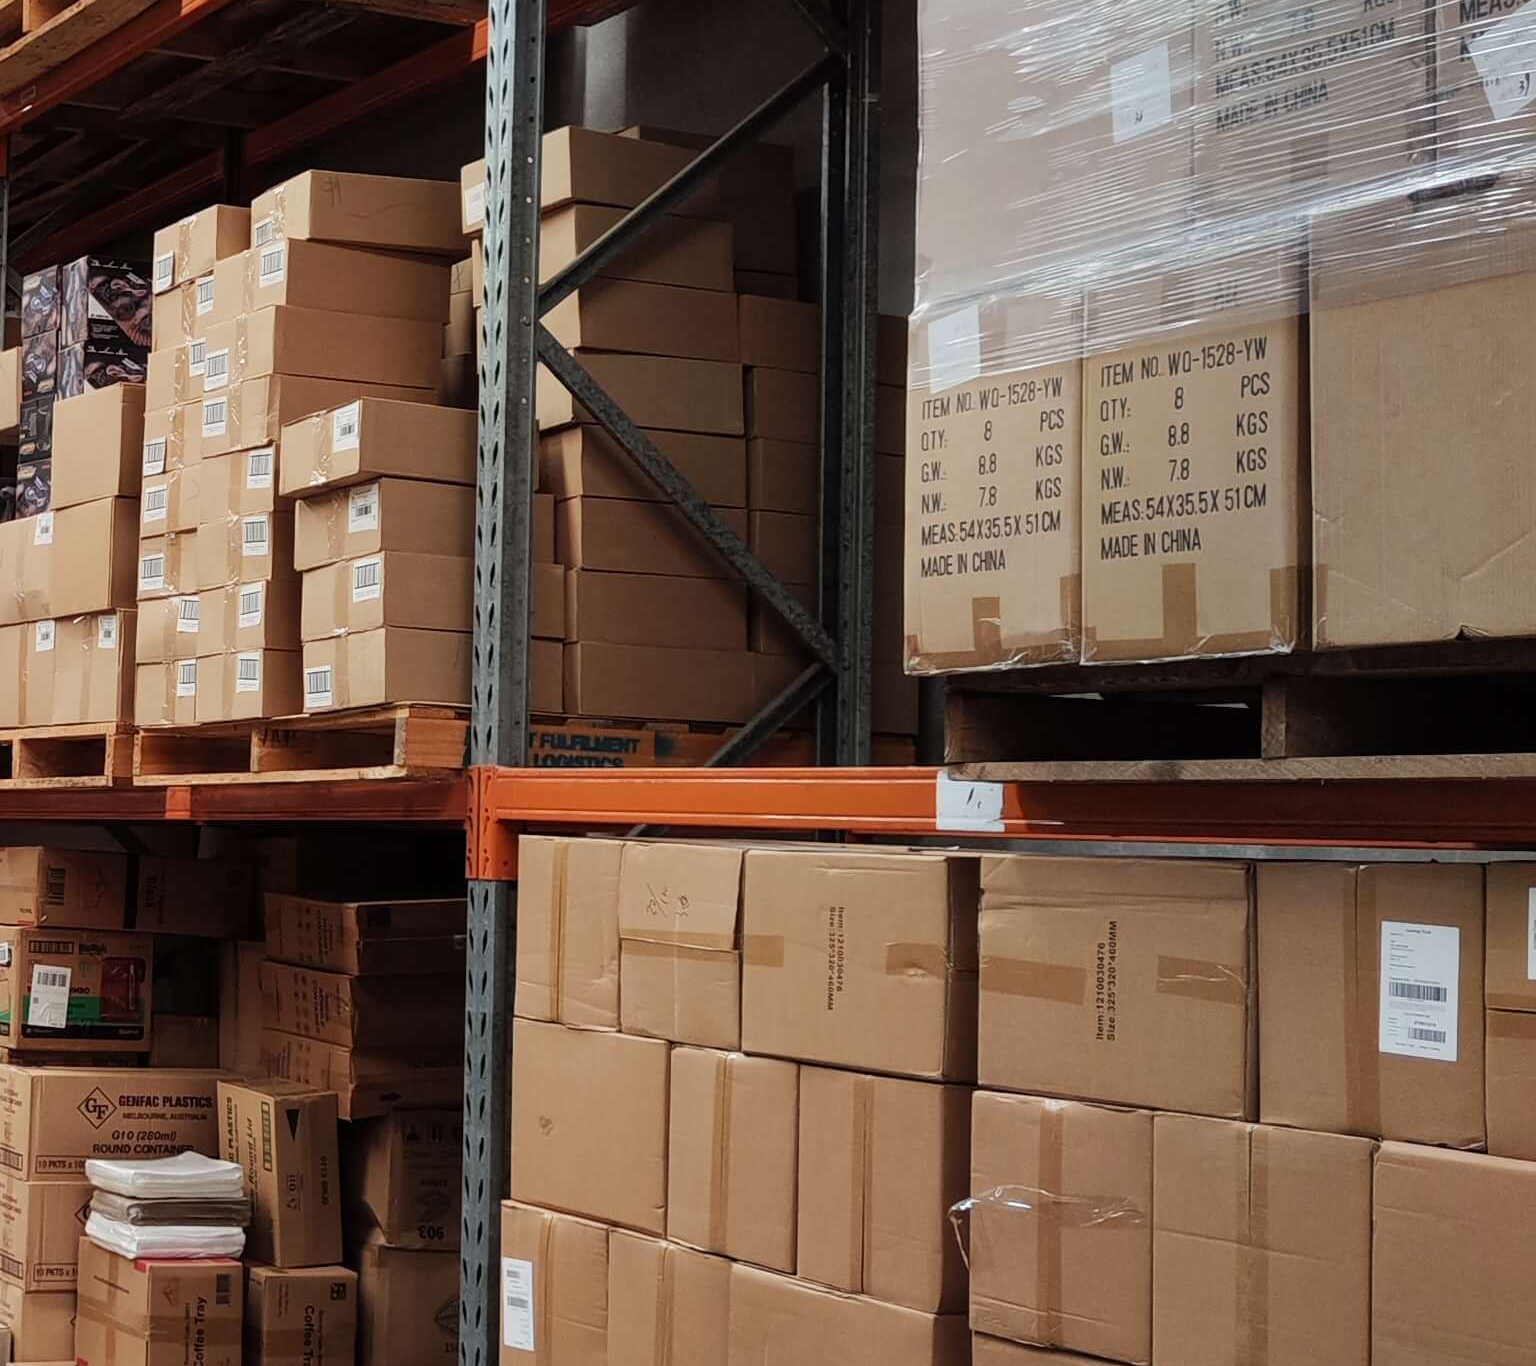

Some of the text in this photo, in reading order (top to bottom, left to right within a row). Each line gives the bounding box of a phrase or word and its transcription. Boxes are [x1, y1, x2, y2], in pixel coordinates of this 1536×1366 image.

[1100, 361, 1134, 388] ITEM
[1240, 371, 1270, 398] PCS
[921, 396, 951, 420] ITEM
[1174, 386, 1184, 411] 8
[983, 420, 993, 442] 8
[1039, 408, 1065, 432] PCS
[1235, 410, 1269, 438] KGS
[1167, 422, 1190, 447] 8.8
[978, 453, 997, 476] 8.8
[1035, 443, 1064, 468] KGS
[1235, 447, 1268, 475] KGS
[1168, 458, 1190, 482] 7.8
[978, 485, 998, 508] 7.8
[1035, 476, 1062, 501] KGS
[1100, 527, 1202, 561] MADE IN CHINA
[920, 549, 1006, 578] MADE IN CHINA
[118, 1095, 212, 1109] GENFAC PLASTICS
[92, 1144, 132, 1154] ROUND
[48, 1160, 67, 1170] PKTS
[193, 1296, 208, 1326] Tray
[303, 1304, 316, 1347] Coffee
